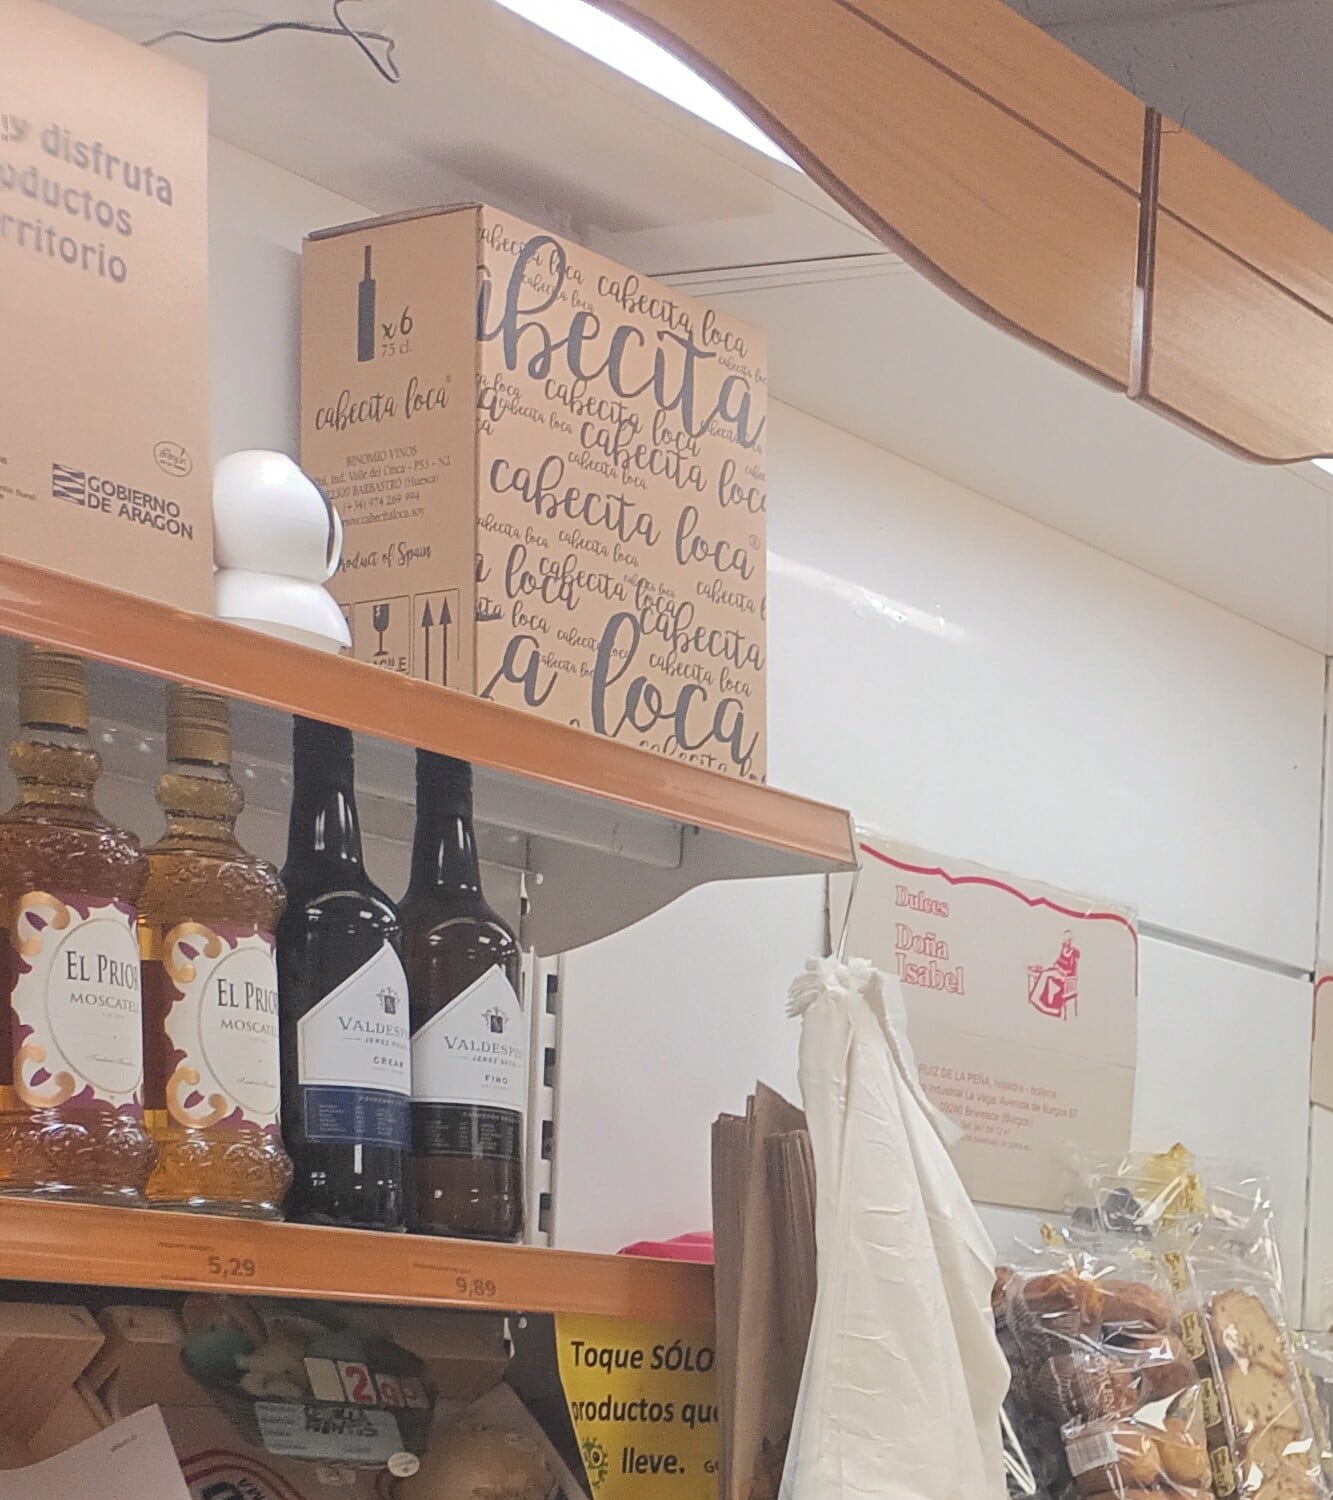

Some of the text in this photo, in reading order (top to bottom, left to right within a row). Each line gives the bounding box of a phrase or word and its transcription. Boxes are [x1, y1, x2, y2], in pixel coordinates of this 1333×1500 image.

[40, 122, 173, 207] disfruta
[597, 274, 748, 358] cabecita loca
[315, 376, 449, 432] cabecita loca
[544, 377, 701, 458] cabecita loca
[580, 418, 708, 492] cabecita
[87, 475, 181, 519] GOBIERNO
[87, 494, 194, 541] DE ARAGON
[490, 454, 755, 581] cabecita loca
[476, 514, 522, 540] abecita
[339, 551, 378, 574] roduct
[612, 543, 640, 568] loca
[505, 544, 581, 611] loca
[539, 553, 630, 602] cabecita
[696, 579, 757, 614] cabecita
[512, 600, 551, 634] loca
[640, 601, 765, 672] cabecita
[591, 611, 760, 767] loca
[650, 649, 753, 699] cabecita loca
[895, 884, 950, 918] Dulces
[895, 922, 950, 960] Doña
[66, 950, 91, 982] EL
[895, 952, 965, 995] Isabel
[217, 977, 278, 1016] EL PRIO
[220, 1018, 278, 1037] MOSCATE
[207, 1255, 257, 1279] 5,29
[455, 1276, 497, 1298] 9,89
[571, 1339, 716, 1374] Toque SÓLO
[621, 1446, 686, 1475] lleve.
